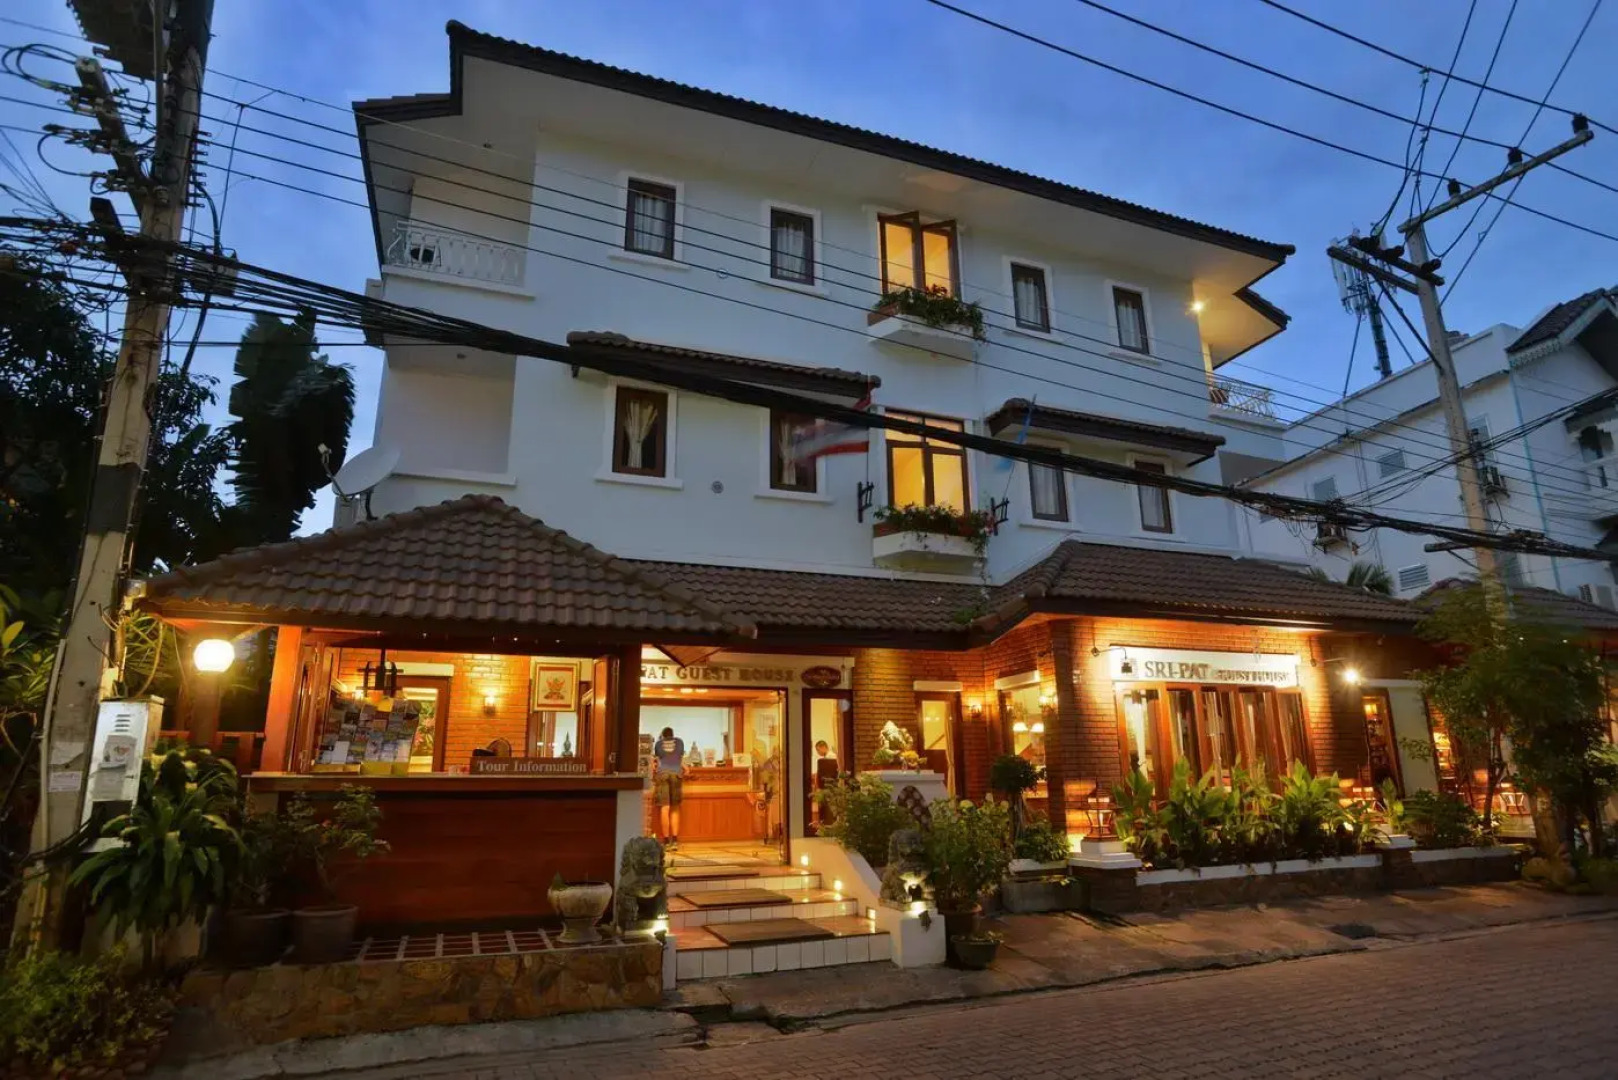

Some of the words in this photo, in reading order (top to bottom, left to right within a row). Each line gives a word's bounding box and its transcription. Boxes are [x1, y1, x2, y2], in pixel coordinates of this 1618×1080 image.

[676, 665, 732, 681] GUEST
[477, 761, 509, 772] Tour
[513, 760, 587, 773] Information
